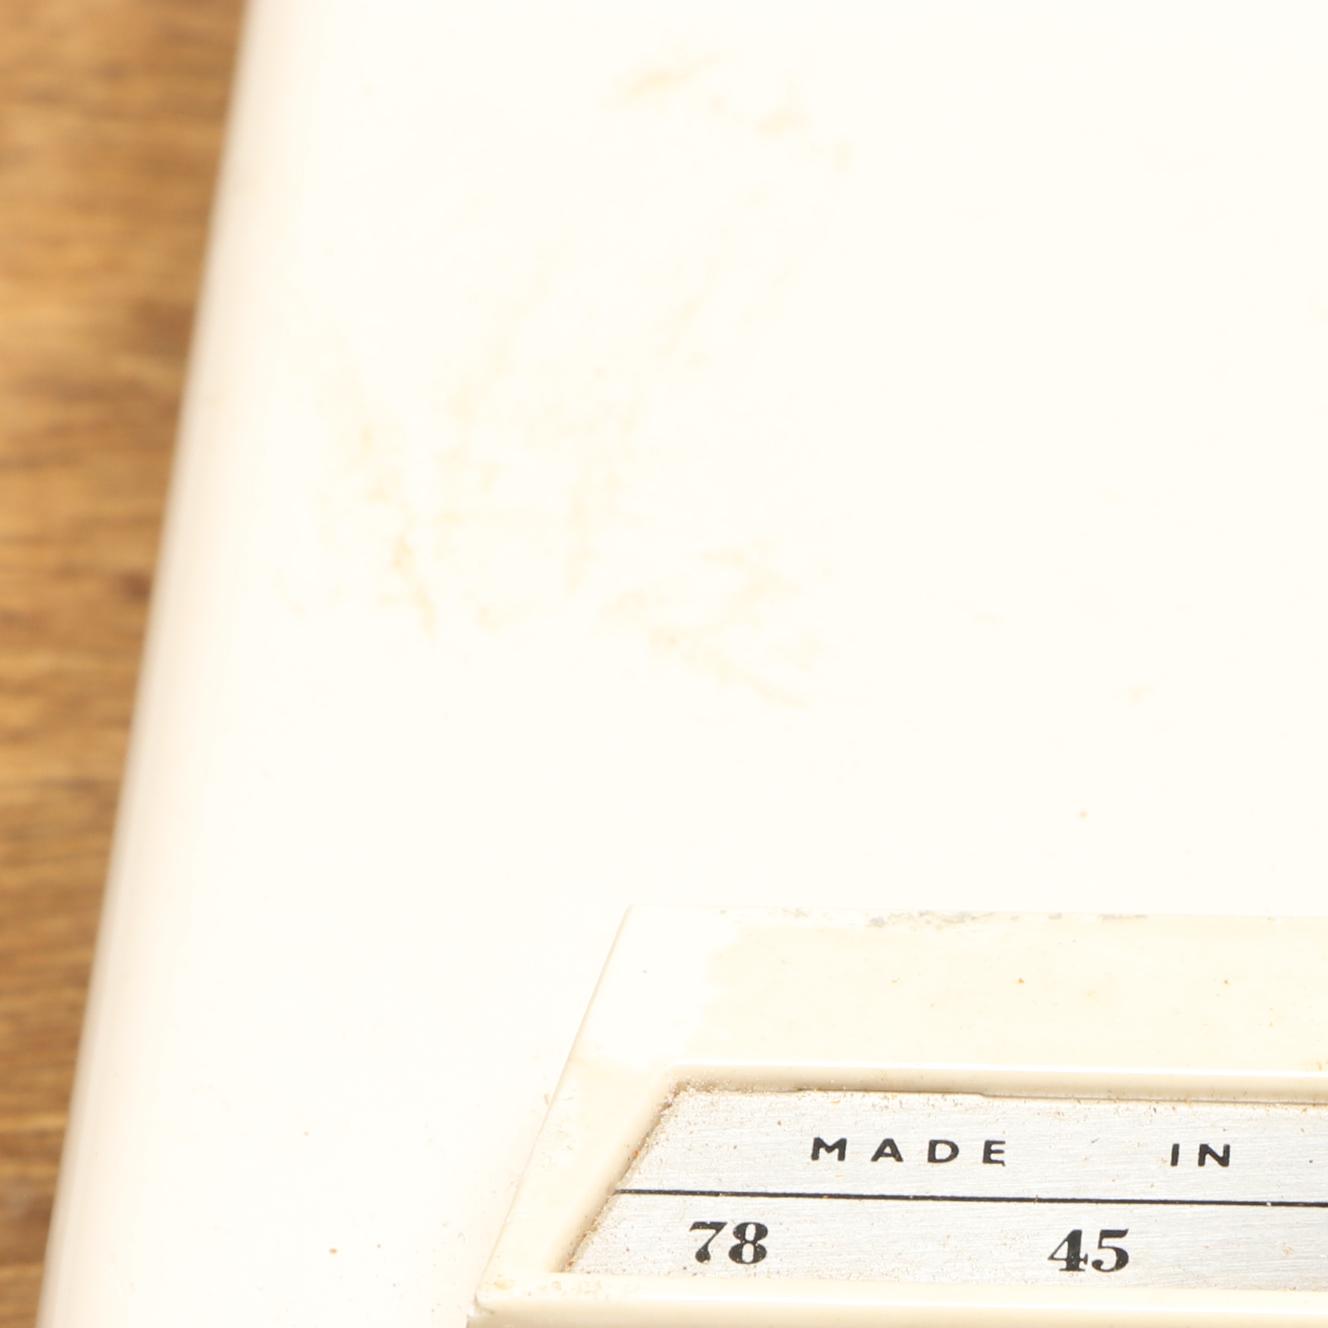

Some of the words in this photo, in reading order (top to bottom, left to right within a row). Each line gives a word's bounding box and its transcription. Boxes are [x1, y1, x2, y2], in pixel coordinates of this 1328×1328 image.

[810, 1136, 1006, 1167] MADE
[1169, 1142, 1232, 1168] IN
[689, 1220, 769, 1265] 78
[1046, 1228, 1130, 1274] 45
